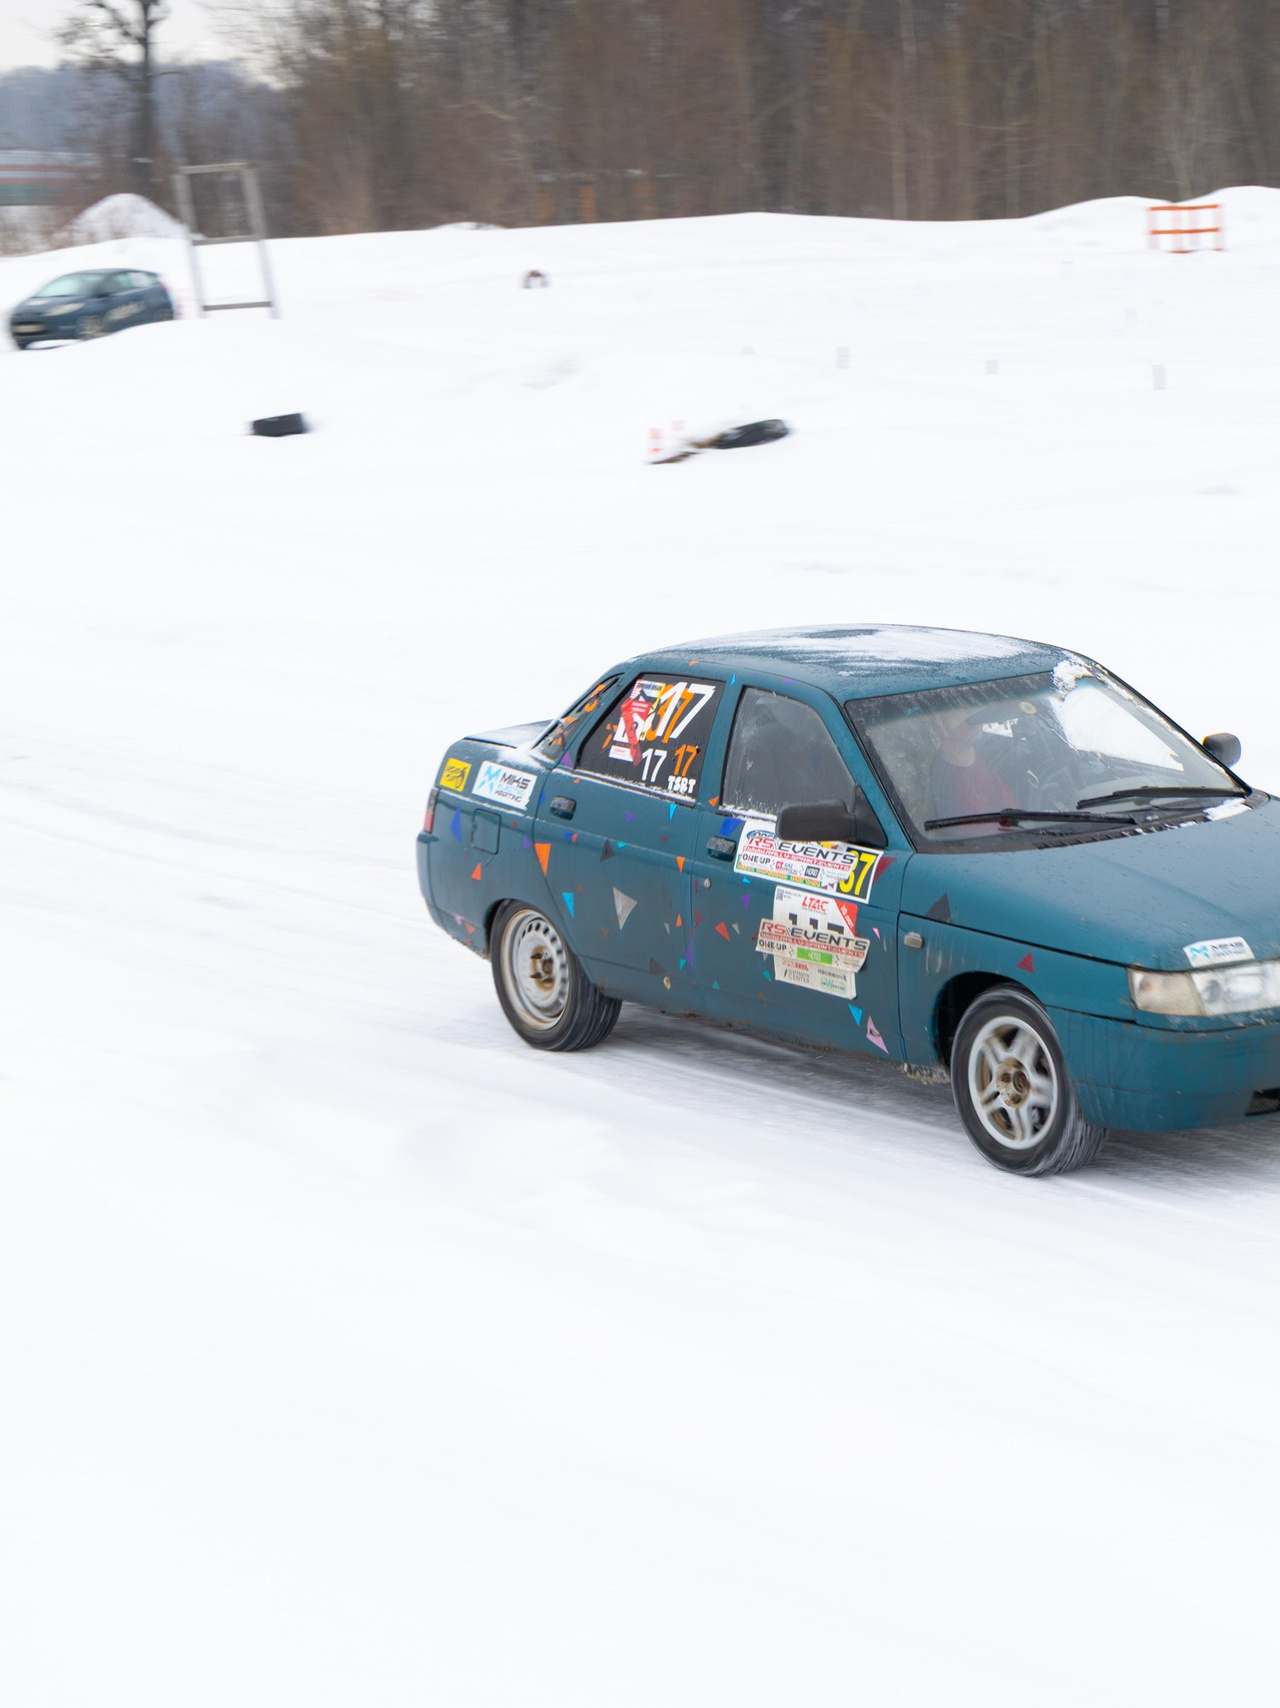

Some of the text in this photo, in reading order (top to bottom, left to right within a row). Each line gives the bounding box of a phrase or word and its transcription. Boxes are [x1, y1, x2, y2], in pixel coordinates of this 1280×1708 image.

[656, 682, 716, 738] 17
[641, 748, 667, 783] 17
[674, 744, 697, 776] 17
[500, 772, 531, 790] MIKS
[748, 837, 858, 865] RS EVENTS
[802, 895, 829, 912] LTAC
[760, 921, 787, 935] RS
[791, 928, 869, 951] EVENTS
